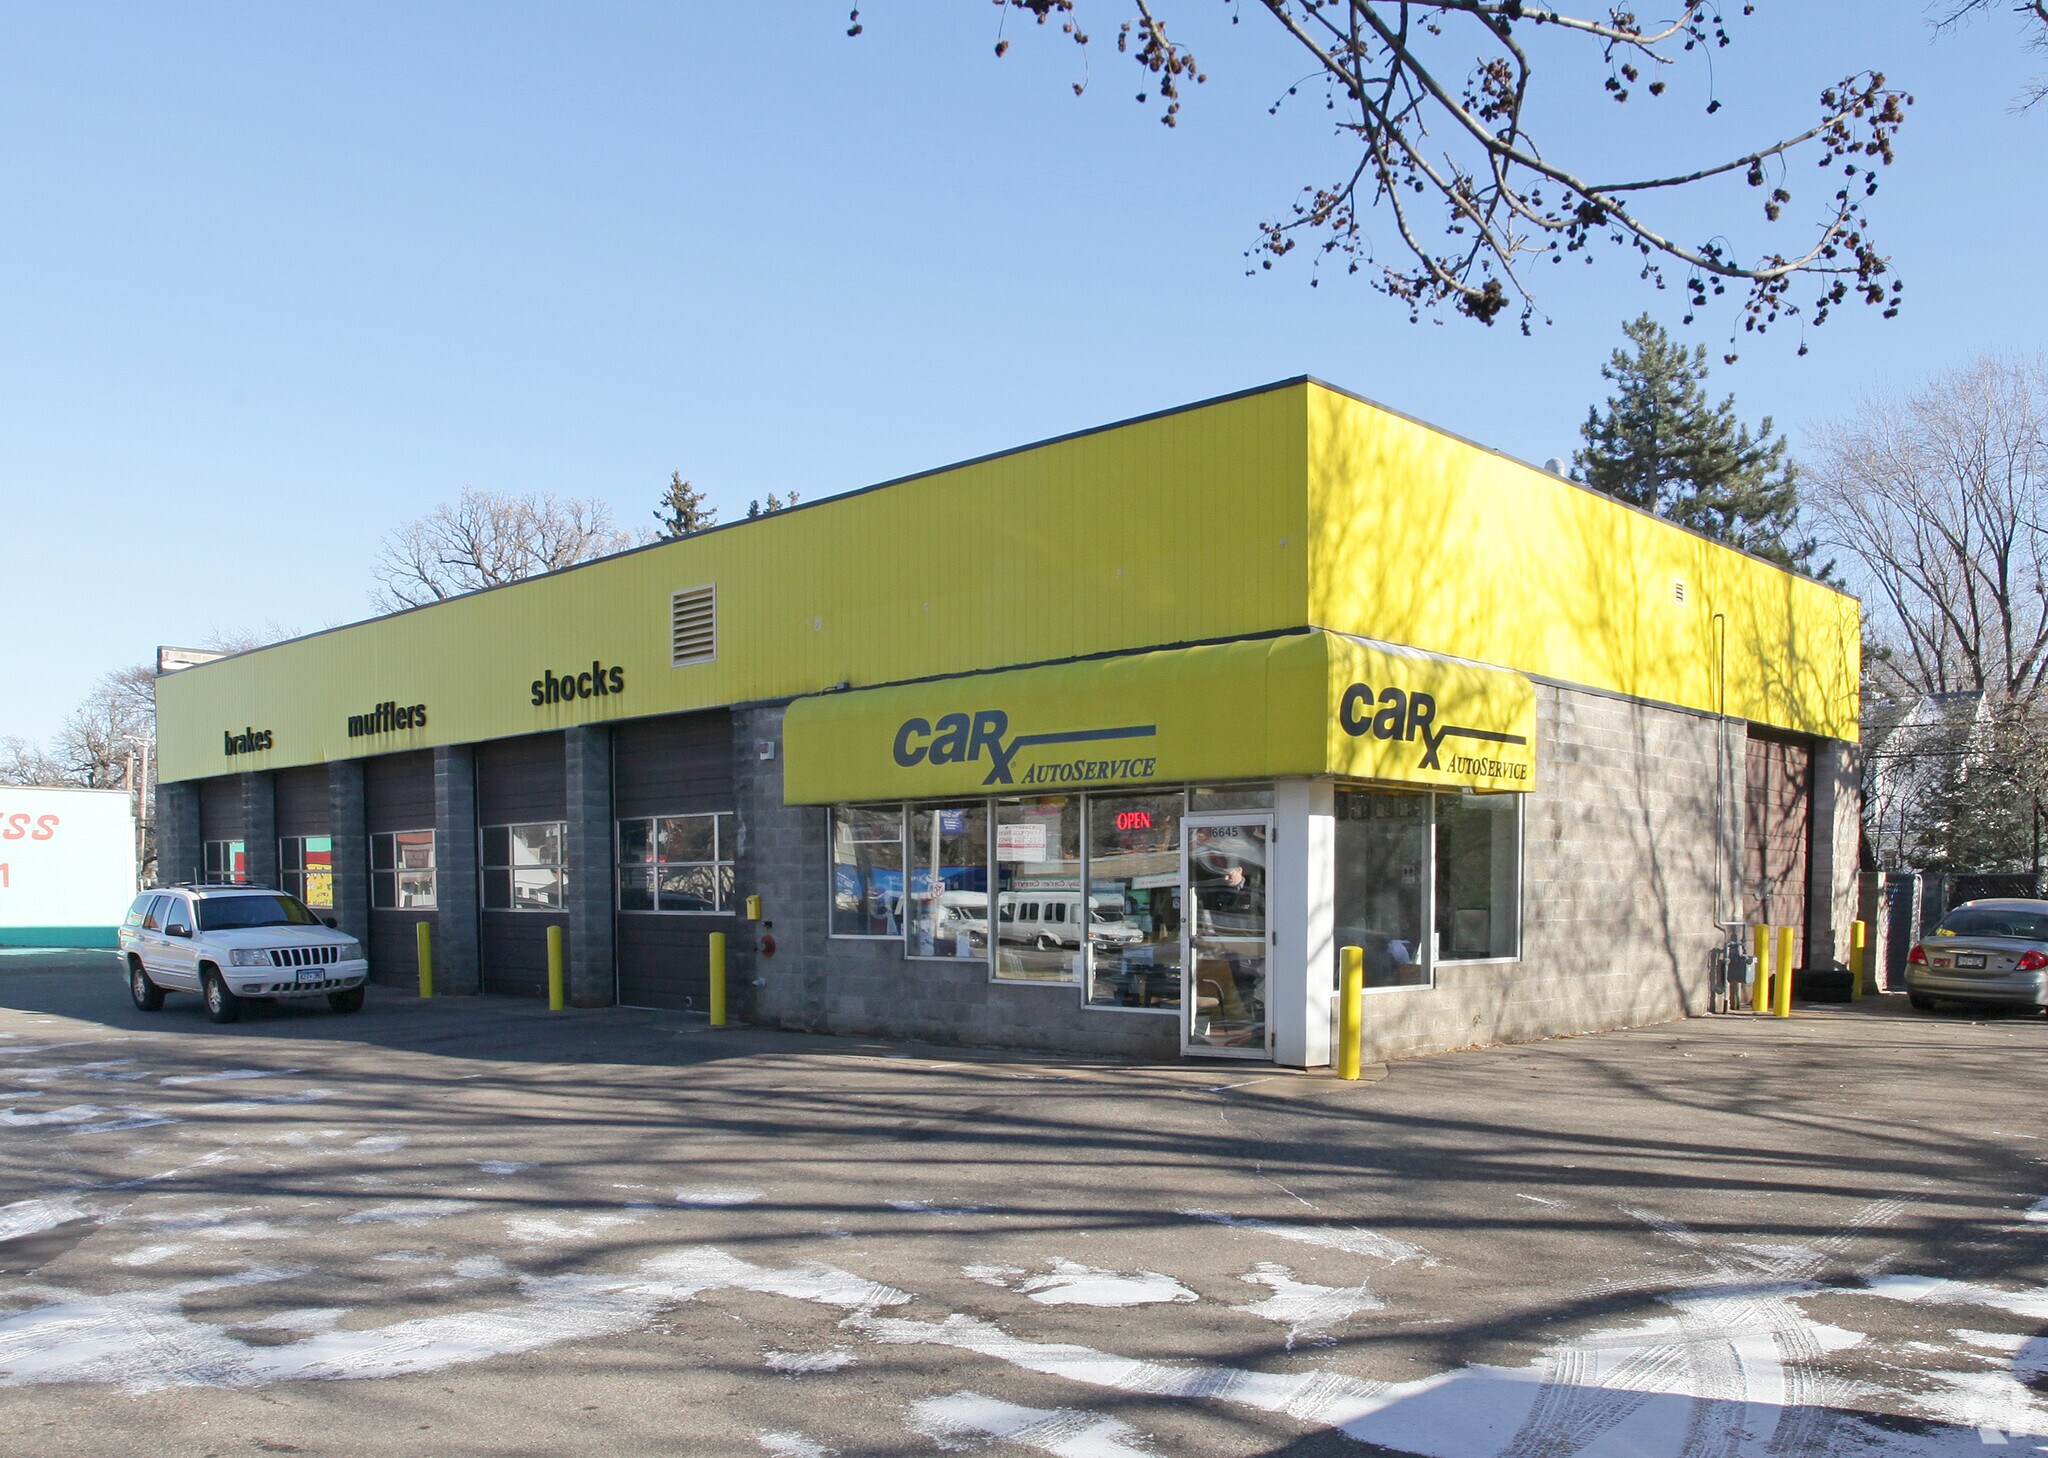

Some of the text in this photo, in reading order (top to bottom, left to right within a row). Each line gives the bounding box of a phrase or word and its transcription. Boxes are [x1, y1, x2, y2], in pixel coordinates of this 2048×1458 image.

[531, 660, 625, 707] shocks
[347, 701, 427, 738] mufflers
[224, 726, 273, 756] brakes
[0, 812, 60, 841] SS
[1116, 811, 1152, 831] OPEN
[1211, 827, 1239, 838] 6645
